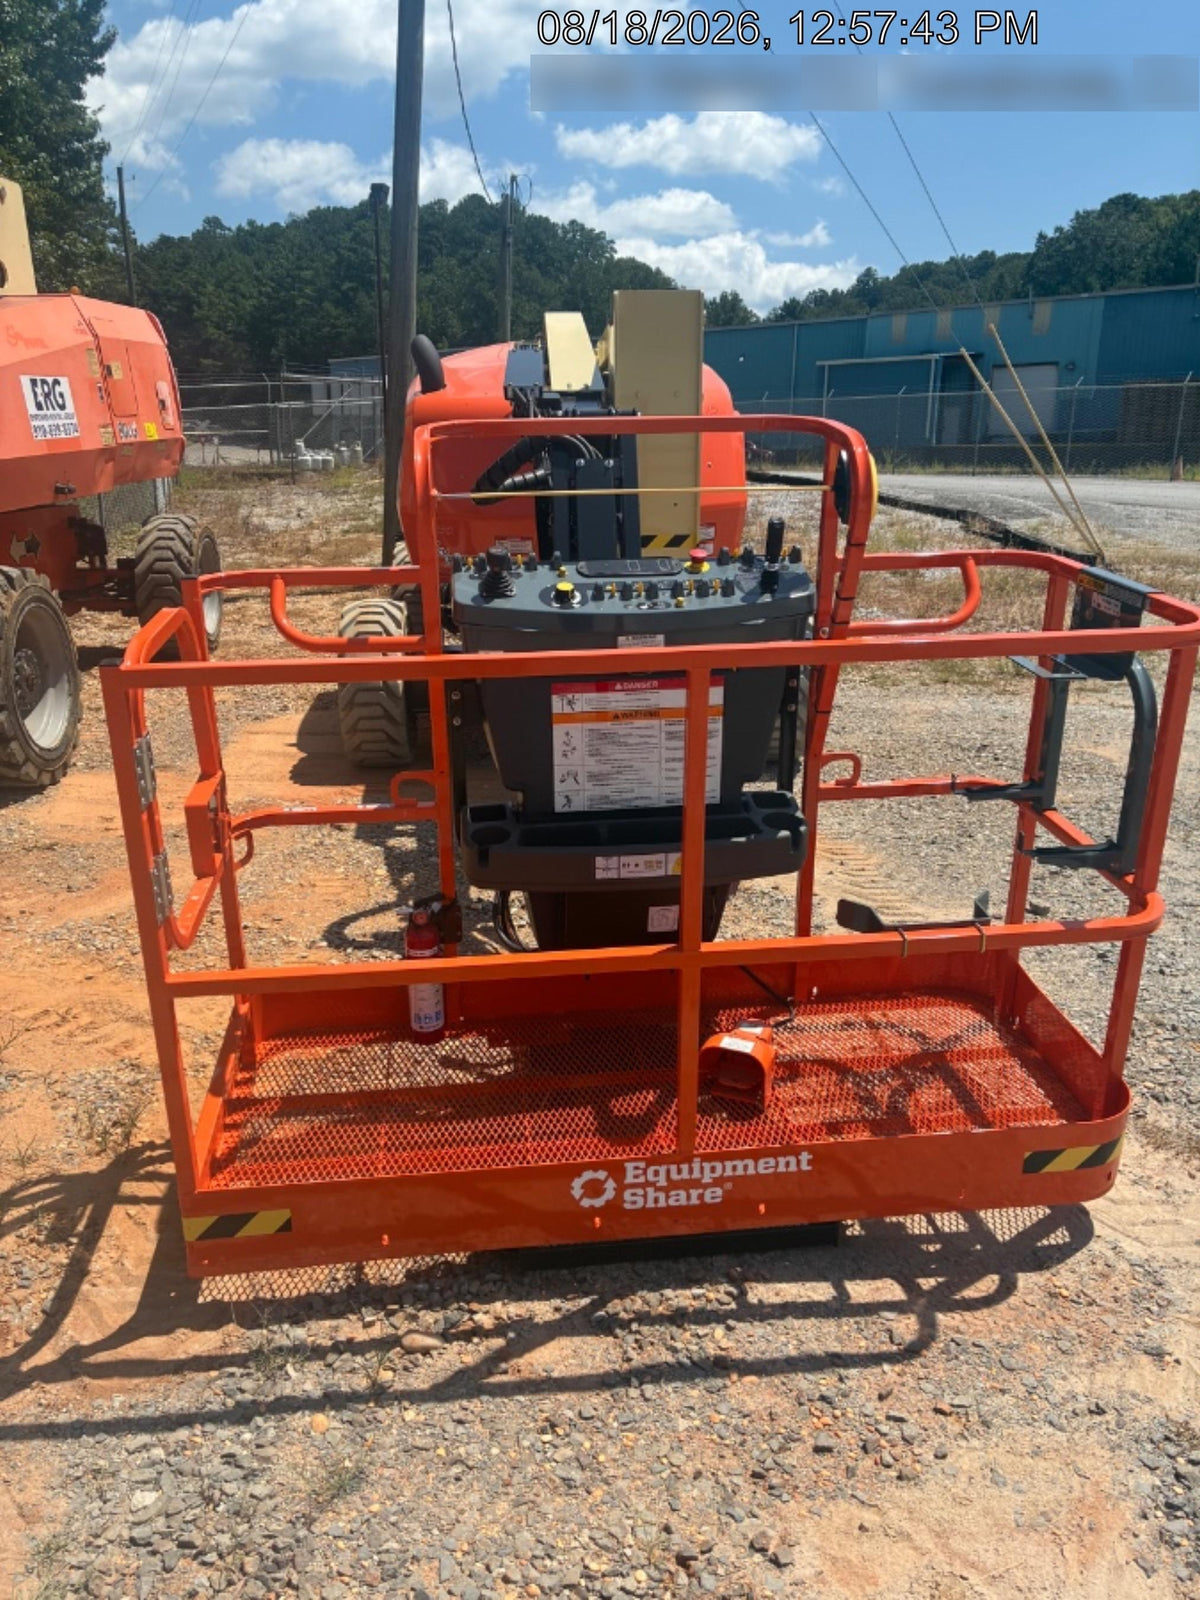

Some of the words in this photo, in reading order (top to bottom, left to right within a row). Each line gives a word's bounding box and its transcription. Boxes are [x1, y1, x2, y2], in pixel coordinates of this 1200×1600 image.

[30, 378, 66, 411] ERG
[623, 1151, 813, 1186] Equipment
[623, 1186, 723, 1209] Share
